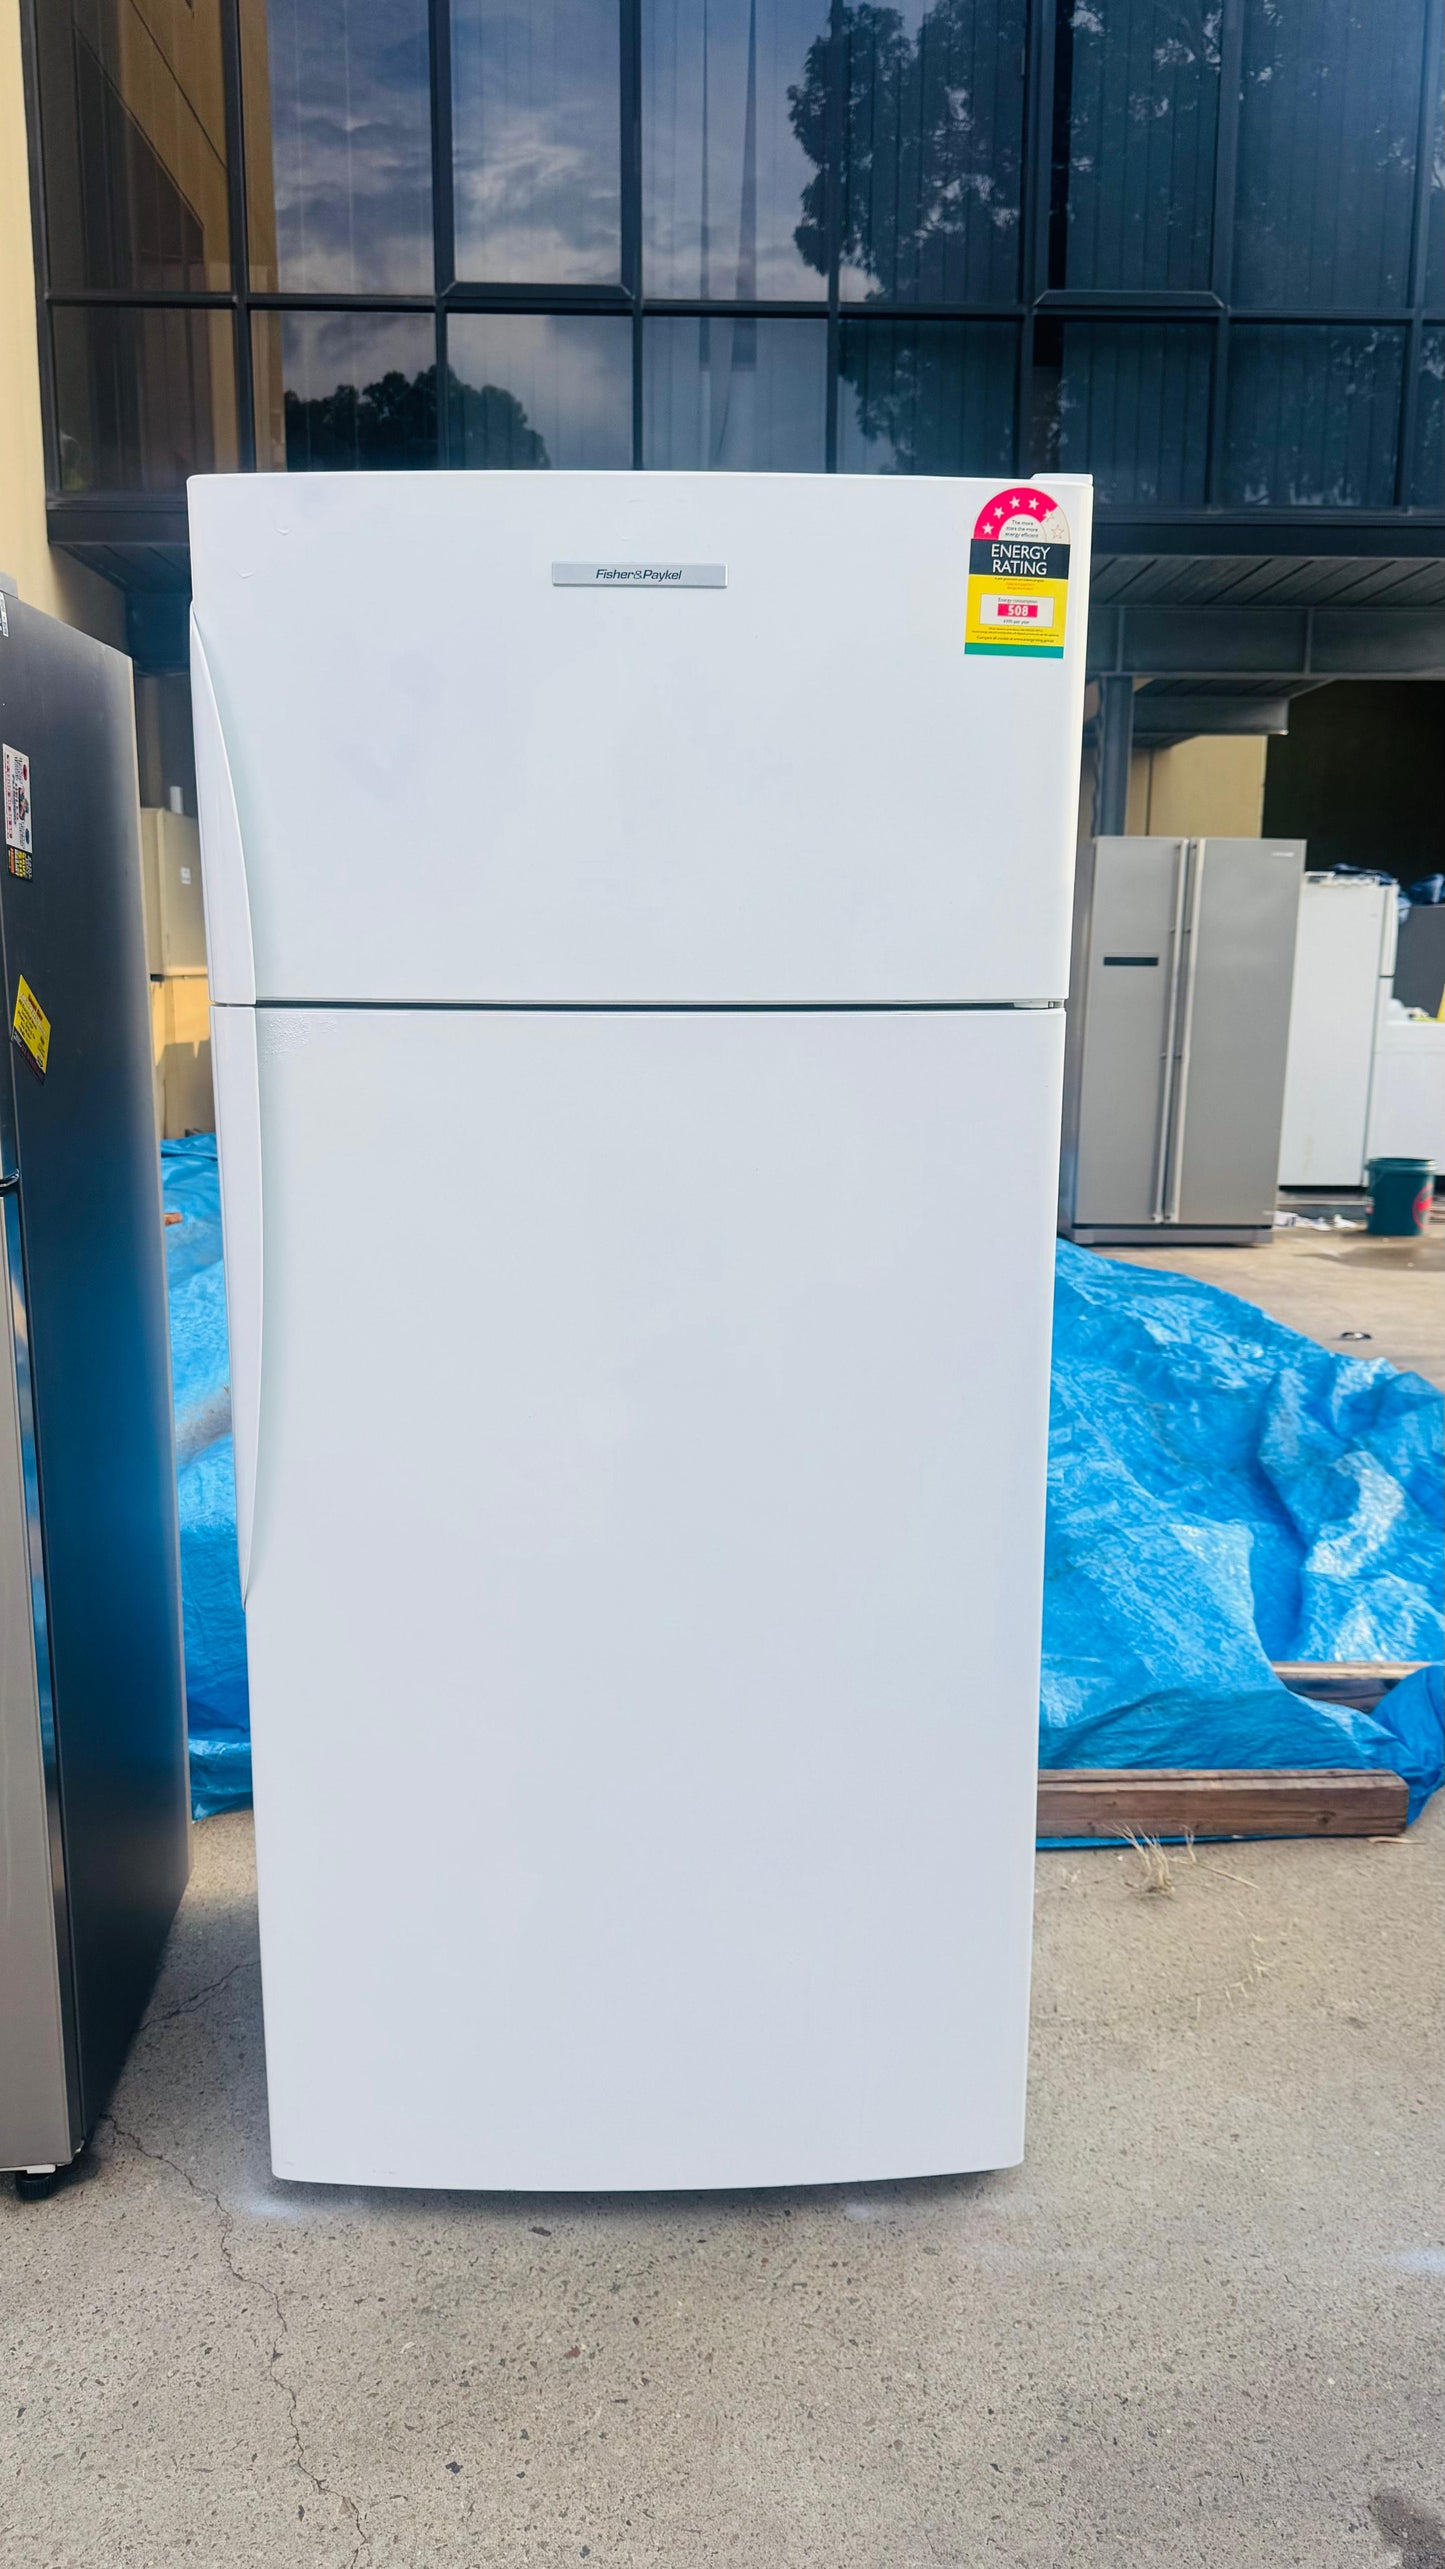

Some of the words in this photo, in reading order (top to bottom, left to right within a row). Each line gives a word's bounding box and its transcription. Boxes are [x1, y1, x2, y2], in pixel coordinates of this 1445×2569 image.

[991, 543, 1051, 560] ENERGY
[992, 559, 1047, 575] RATING
[596, 569, 682, 582] Fisher&Paykel
[1007, 604, 1029, 616] 508
